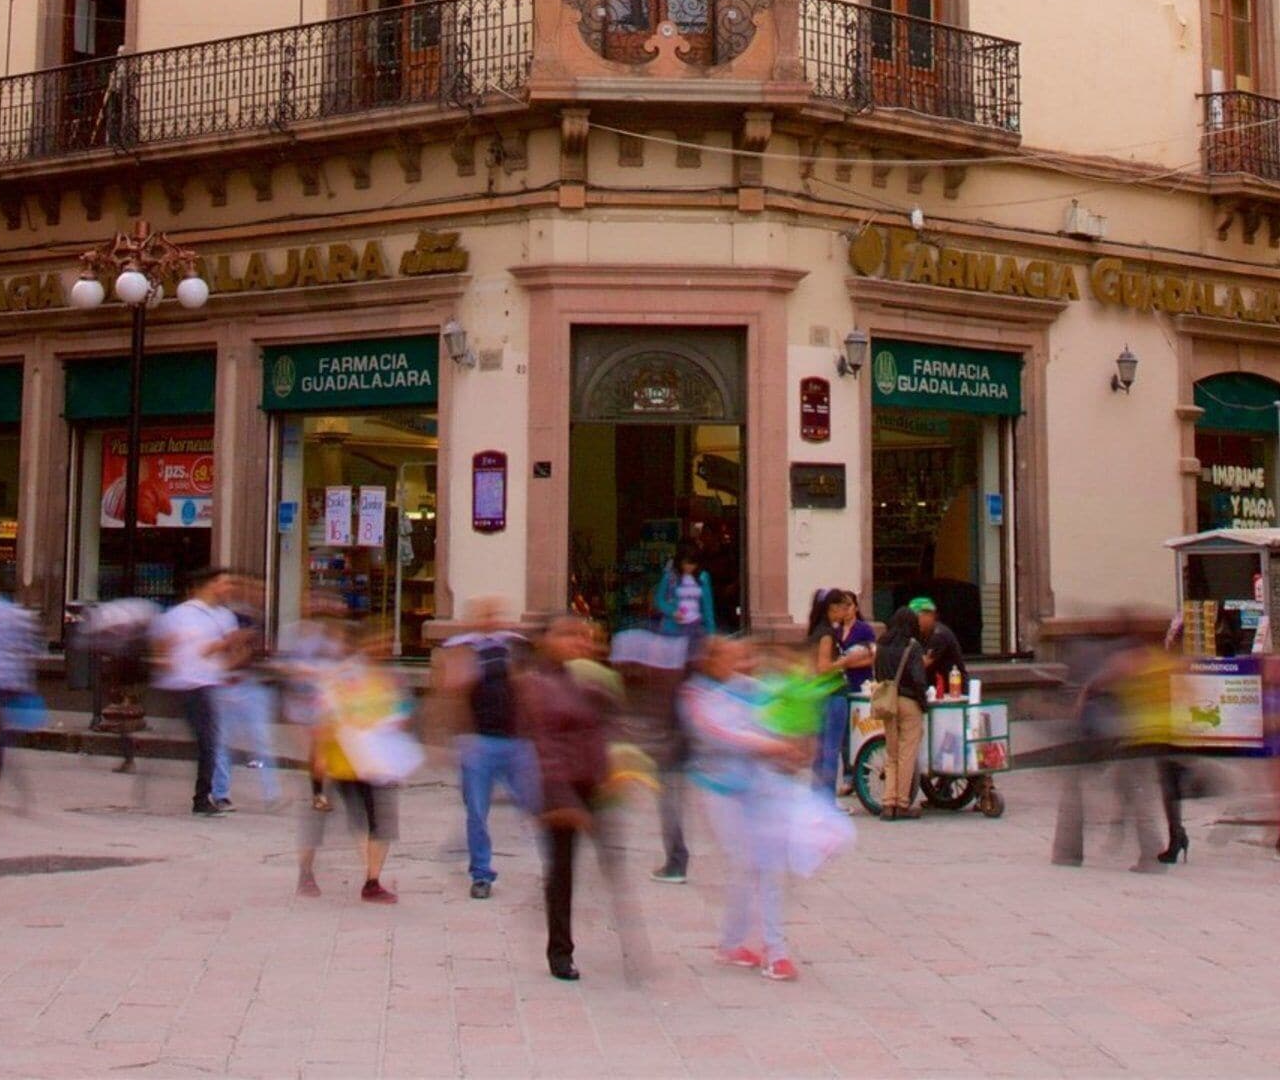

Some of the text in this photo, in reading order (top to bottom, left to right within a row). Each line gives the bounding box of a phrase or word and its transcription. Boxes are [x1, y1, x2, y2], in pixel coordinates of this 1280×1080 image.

[887, 228, 1080, 301] FARMACIA
[318, 353, 408, 373] FARMACIA
[913, 358, 991, 380] FARMACIA
[301, 370, 432, 392] GUADALAJARA
[897, 375, 1009, 399] GUADALAJARA
[1212, 464, 1265, 489] IMPRIME
[1230, 495, 1276, 519] Y PAGA
